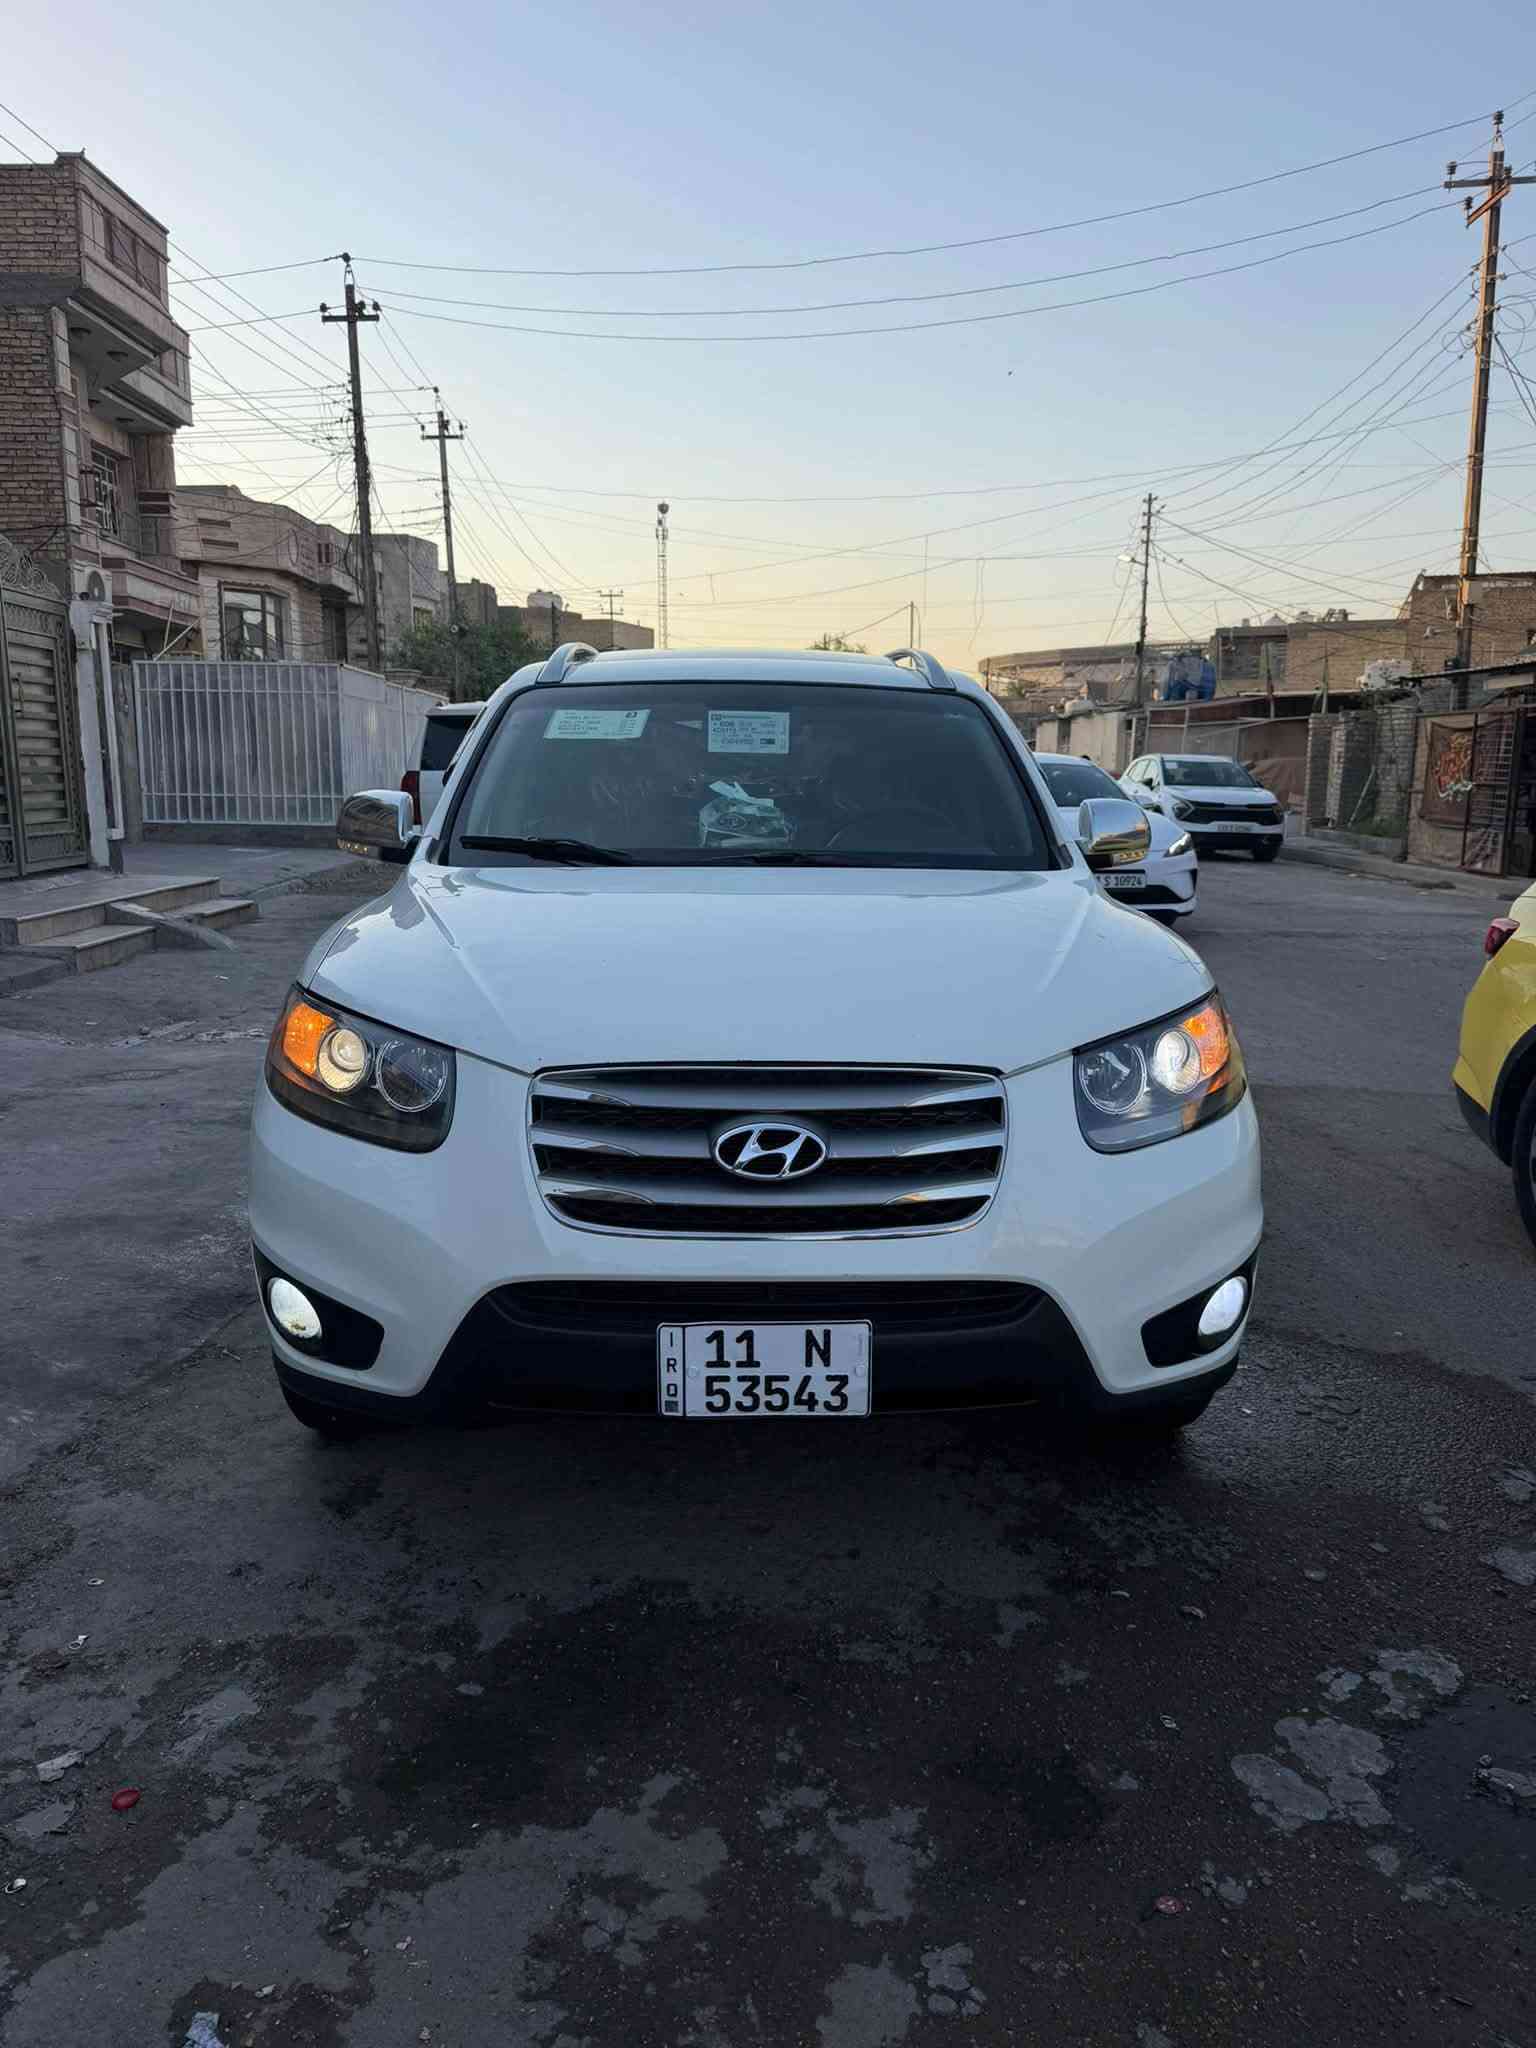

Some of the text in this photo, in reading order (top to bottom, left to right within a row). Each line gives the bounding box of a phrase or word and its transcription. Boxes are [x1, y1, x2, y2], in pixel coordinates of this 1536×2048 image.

[705, 1329, 761, 1368] 11
[804, 1329, 831, 1368] N
[705, 1374, 849, 1413] 53543
